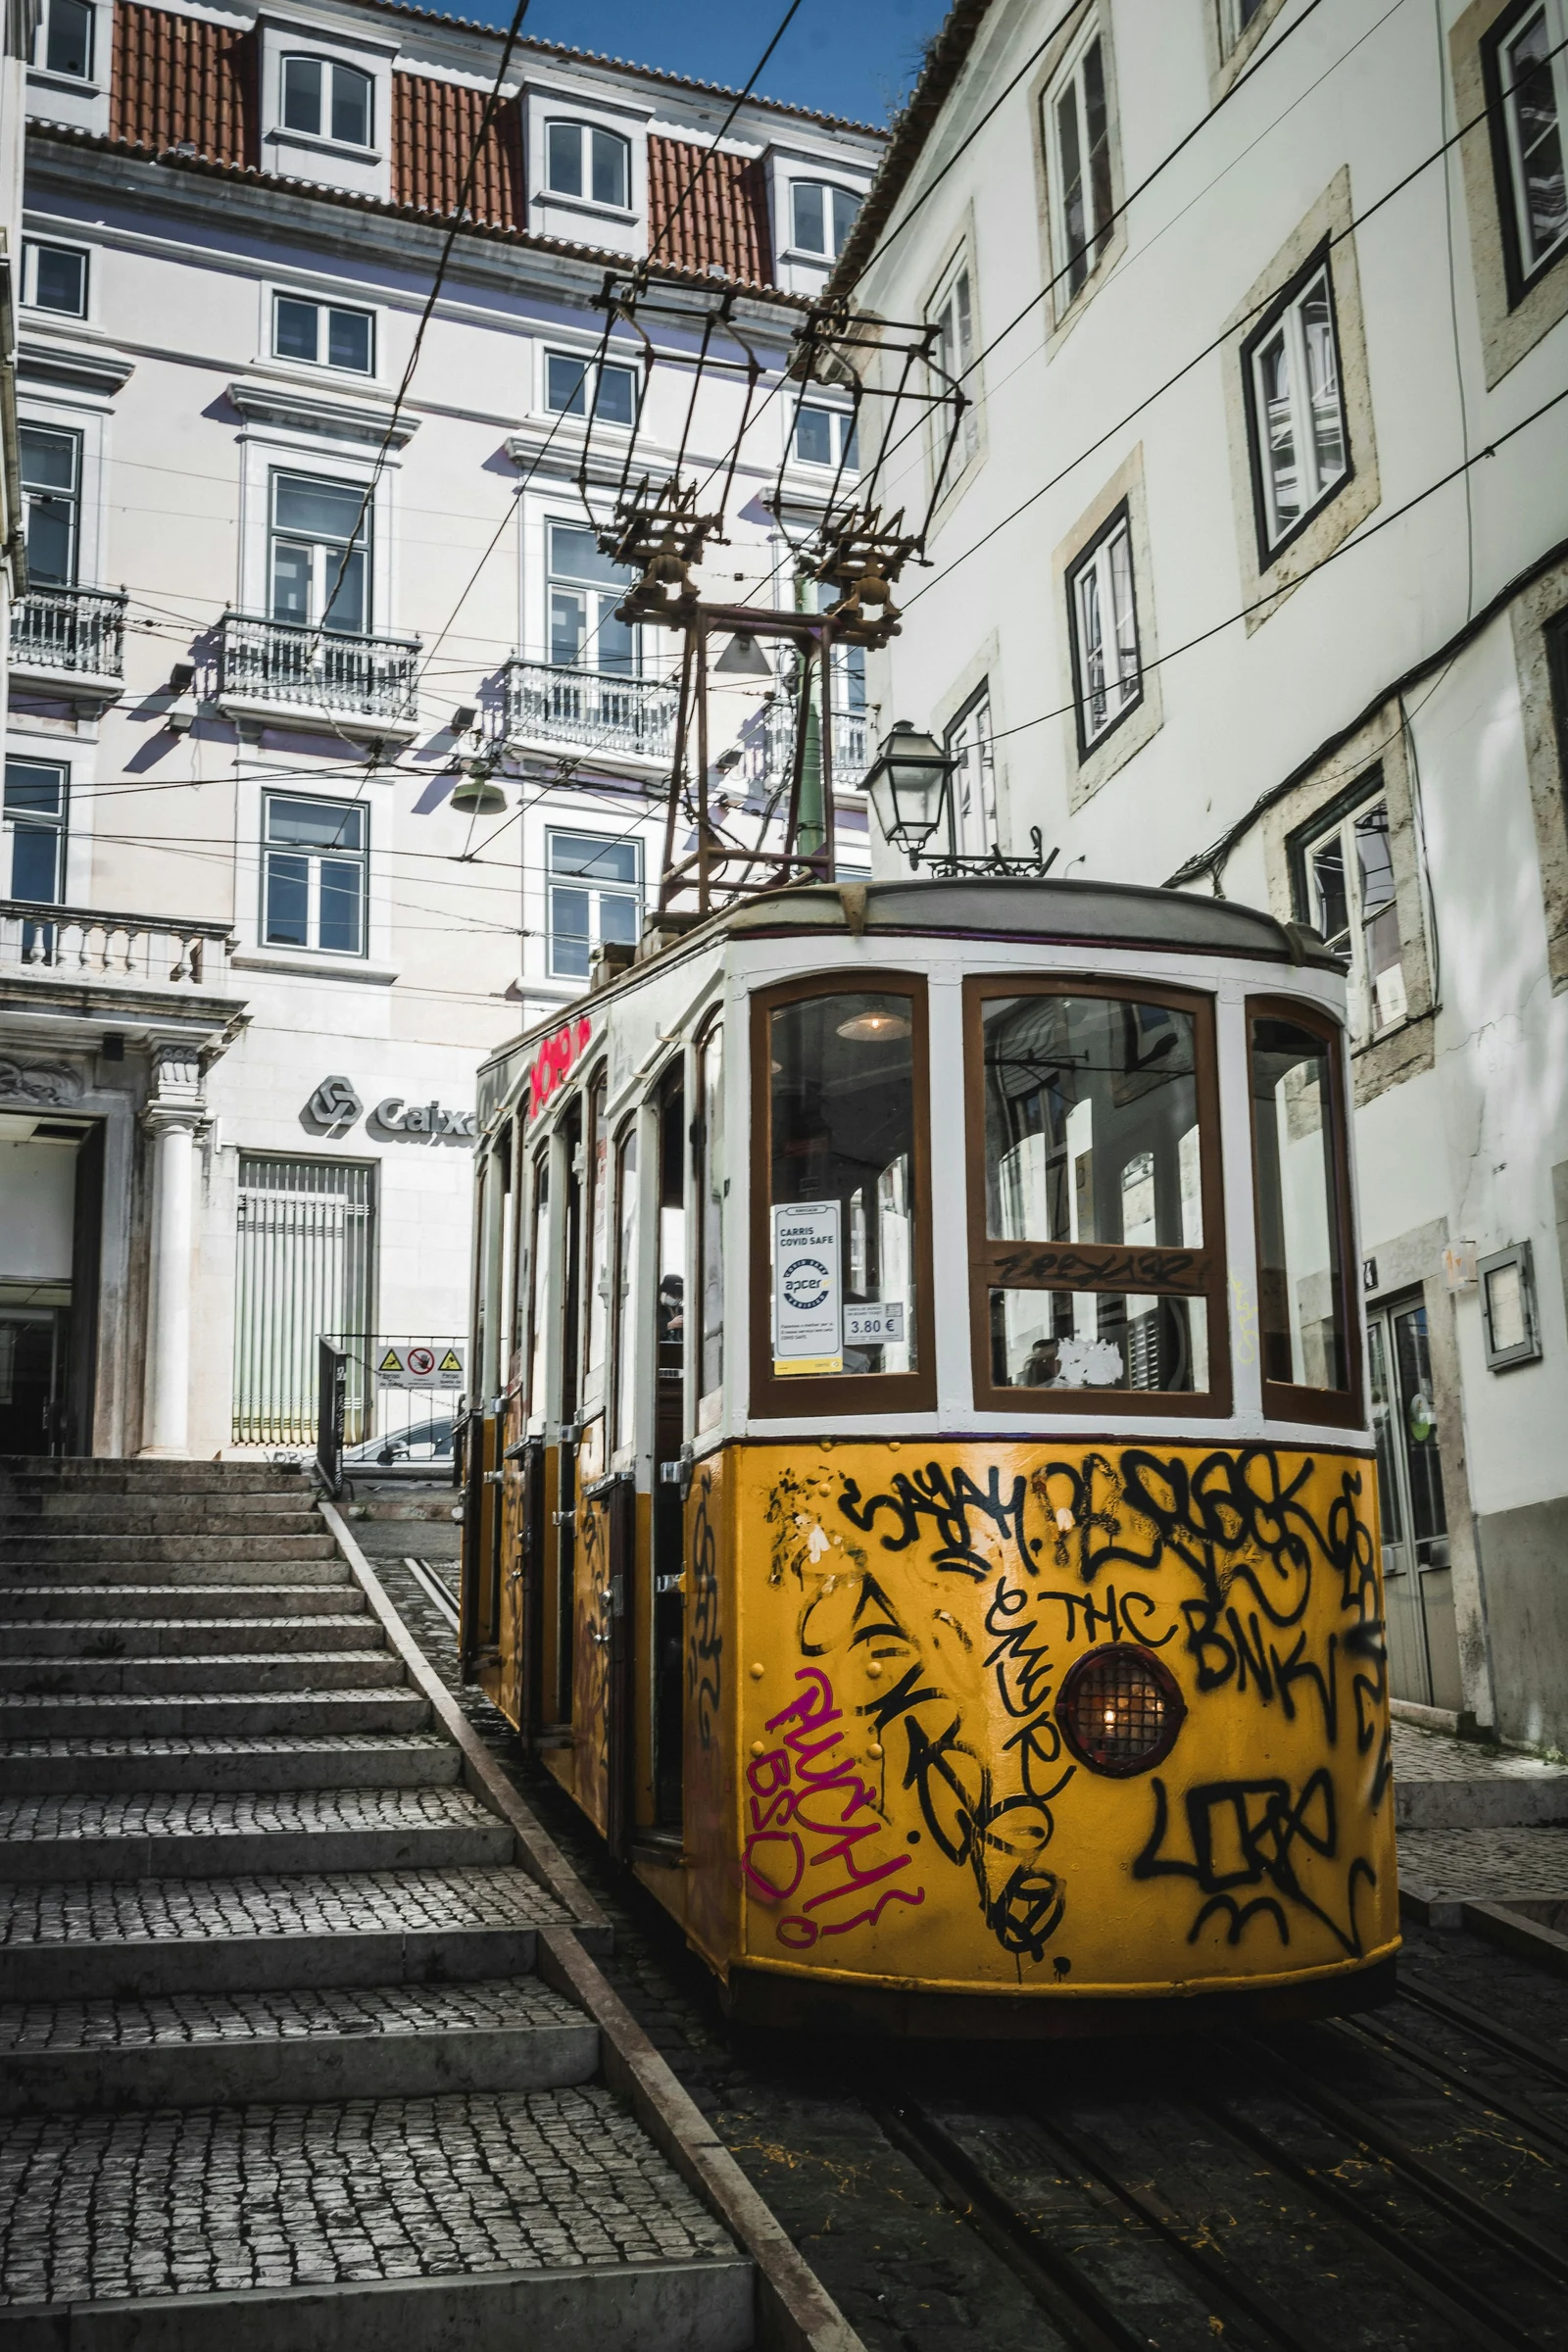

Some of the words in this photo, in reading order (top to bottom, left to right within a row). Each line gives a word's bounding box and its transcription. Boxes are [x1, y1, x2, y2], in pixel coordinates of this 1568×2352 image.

[780, 1227, 814, 1237] CARRIS
[780, 1238, 808, 1247] COVID
[809, 1236, 834, 1245] SAFE
[851, 1320, 881, 1333] 3.80
[885, 1319, 895, 1332] €
